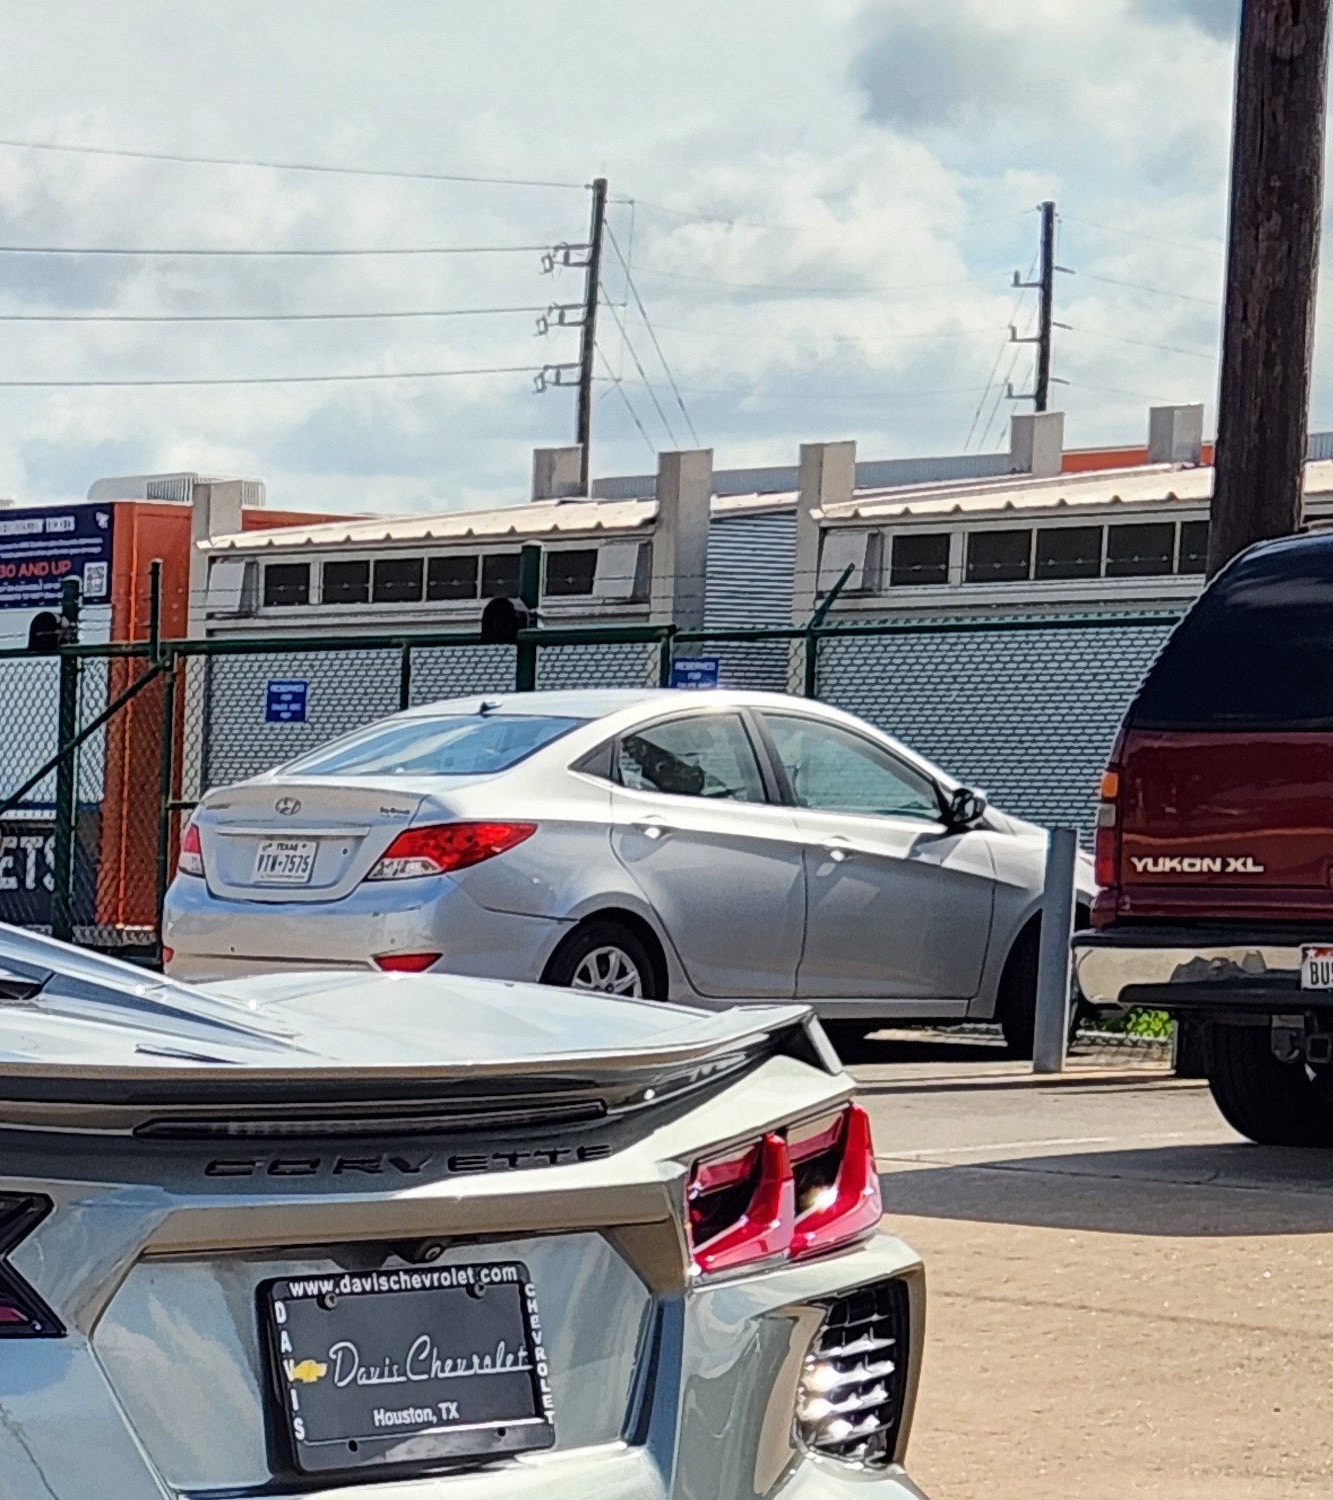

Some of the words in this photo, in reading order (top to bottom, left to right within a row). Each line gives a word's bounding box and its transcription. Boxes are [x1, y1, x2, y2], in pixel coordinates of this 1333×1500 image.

[18, 562, 49, 577] AND
[51, 560, 72, 575] UP
[1130, 856, 1222, 873] YUKON
[1225, 857, 1265, 873] XL
[204, 1144, 613, 1177] CORVETTE
[289, 1264, 518, 1297] www.davischevrolet.com
[328, 1340, 407, 1388] Davis
[405, 1334, 535, 1382] Chevrolet
[523, 1283, 556, 1424] CHEVROLET
[273, 1301, 306, 1441] DAVIS
[372, 1405, 437, 1427] Houston,
[437, 1402, 460, 1421] TX
